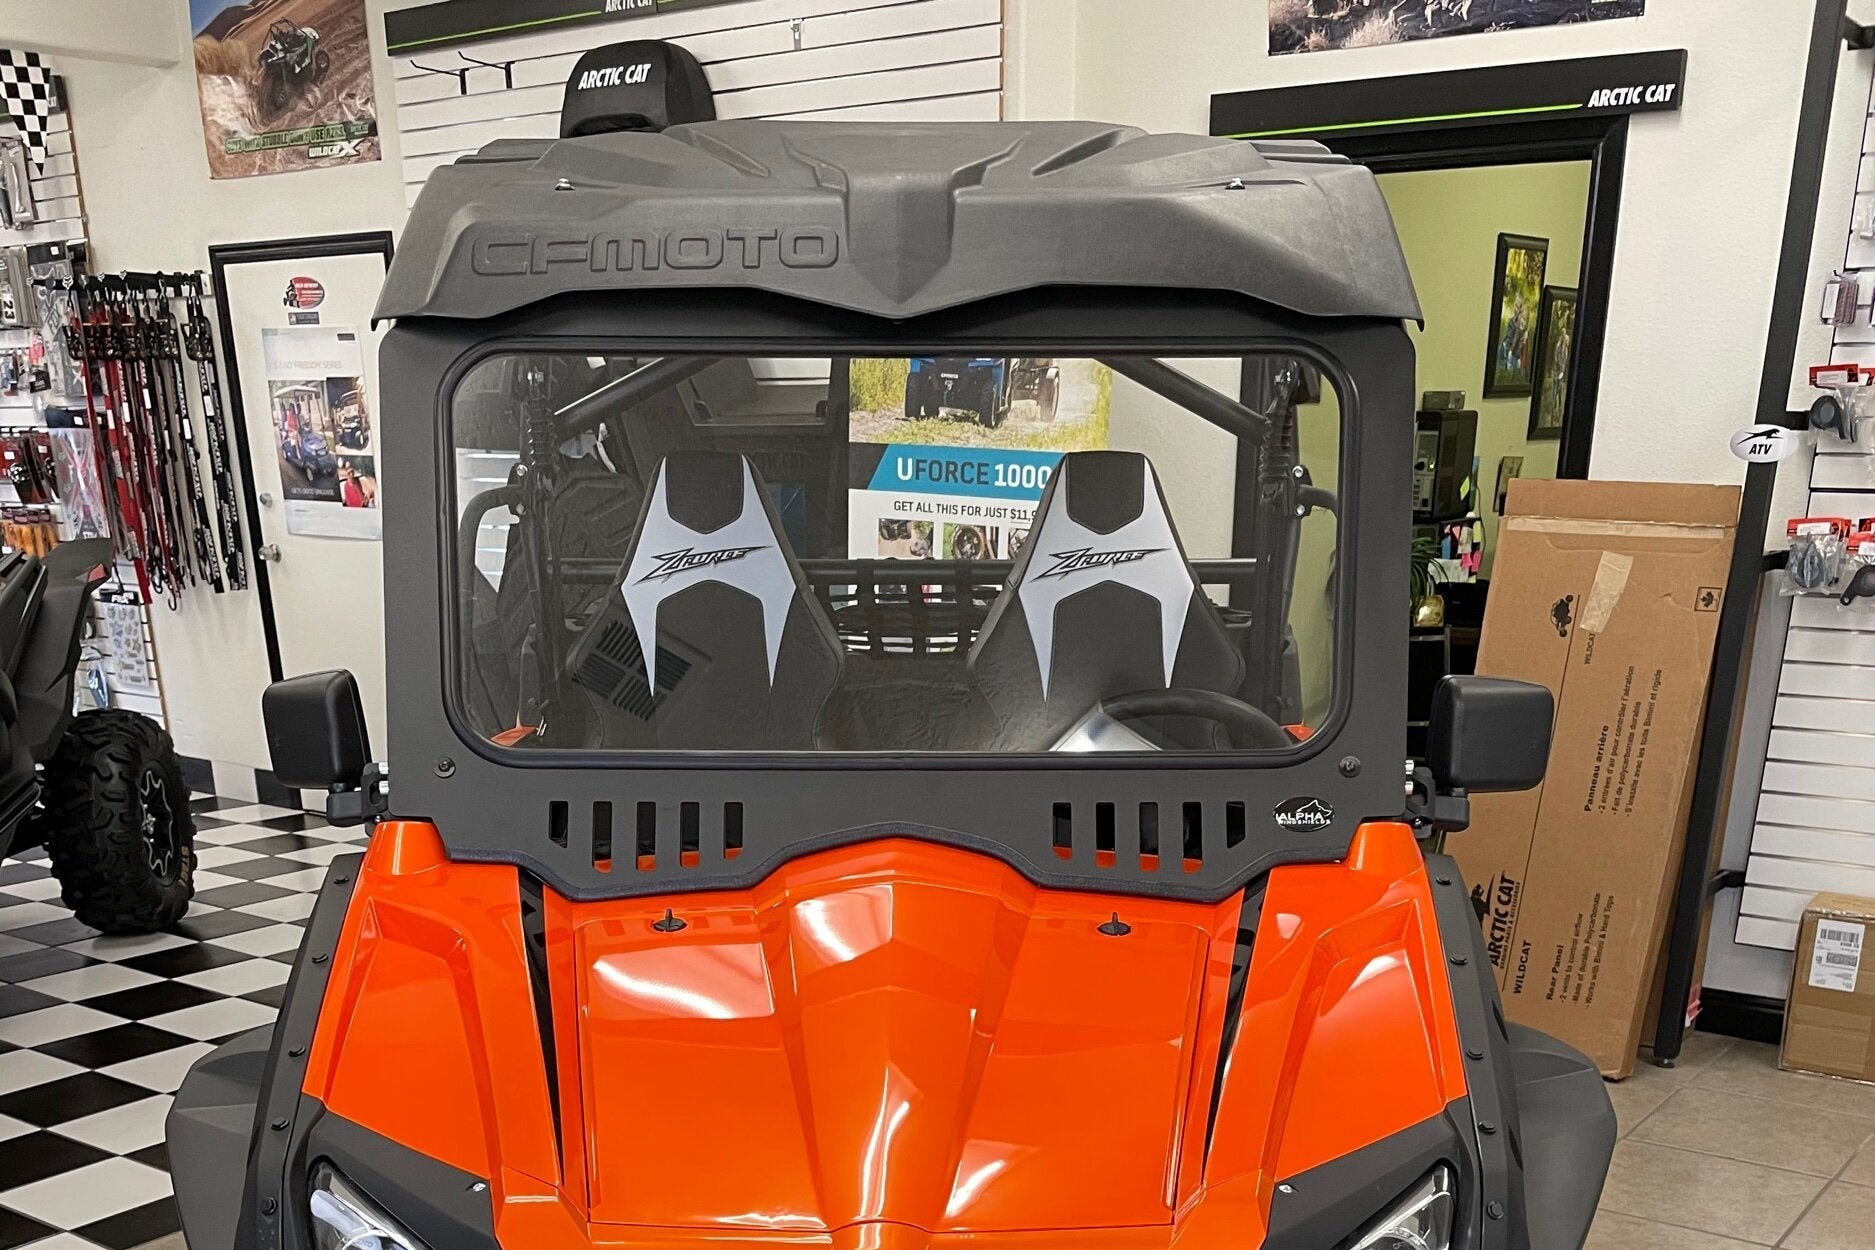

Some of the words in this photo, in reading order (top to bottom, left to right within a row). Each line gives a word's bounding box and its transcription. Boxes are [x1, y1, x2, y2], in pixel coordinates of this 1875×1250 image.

[577, 65, 624, 90] ARCTIC
[625, 63, 652, 84] CAT
[1587, 86, 1643, 108] ARCTIC
[1645, 83, 1676, 103] CAT
[471, 227, 840, 276] CFMOTO
[1749, 443, 1772, 455] ATV
[897, 457, 990, 485] UFORCE
[994, 463, 1052, 489] 1000
[893, 500, 913, 513] GET
[916, 502, 933, 513] ALL
[936, 503, 958, 515] THIS
[961, 505, 981, 517] FOR
[983, 507, 1008, 519] JUST
[1583, 632, 1596, 665] WILDCAT
[1629, 701, 1641, 731] durable
[1611, 738, 1620, 757] pour
[1619, 732, 1635, 785] polycarbonate
[1637, 747, 1646, 759] les
[1584, 764, 1601, 812] Panneau
[1596, 725, 1609, 763] arrière
[1634, 760, 1643, 778] avec
[1616, 786, 1624, 796] de
[1279, 811, 1325, 821] ALPHA
[1497, 870, 1516, 906] CAT
[1604, 895, 1615, 913] Tops
[1600, 914, 1611, 932] Hard
[1487, 907, 1510, 967] ARCTIC
[1513, 939, 1532, 994] WILDCAT
[1546, 977, 1557, 1000] Rear
[1552, 944, 1564, 974] Panel
